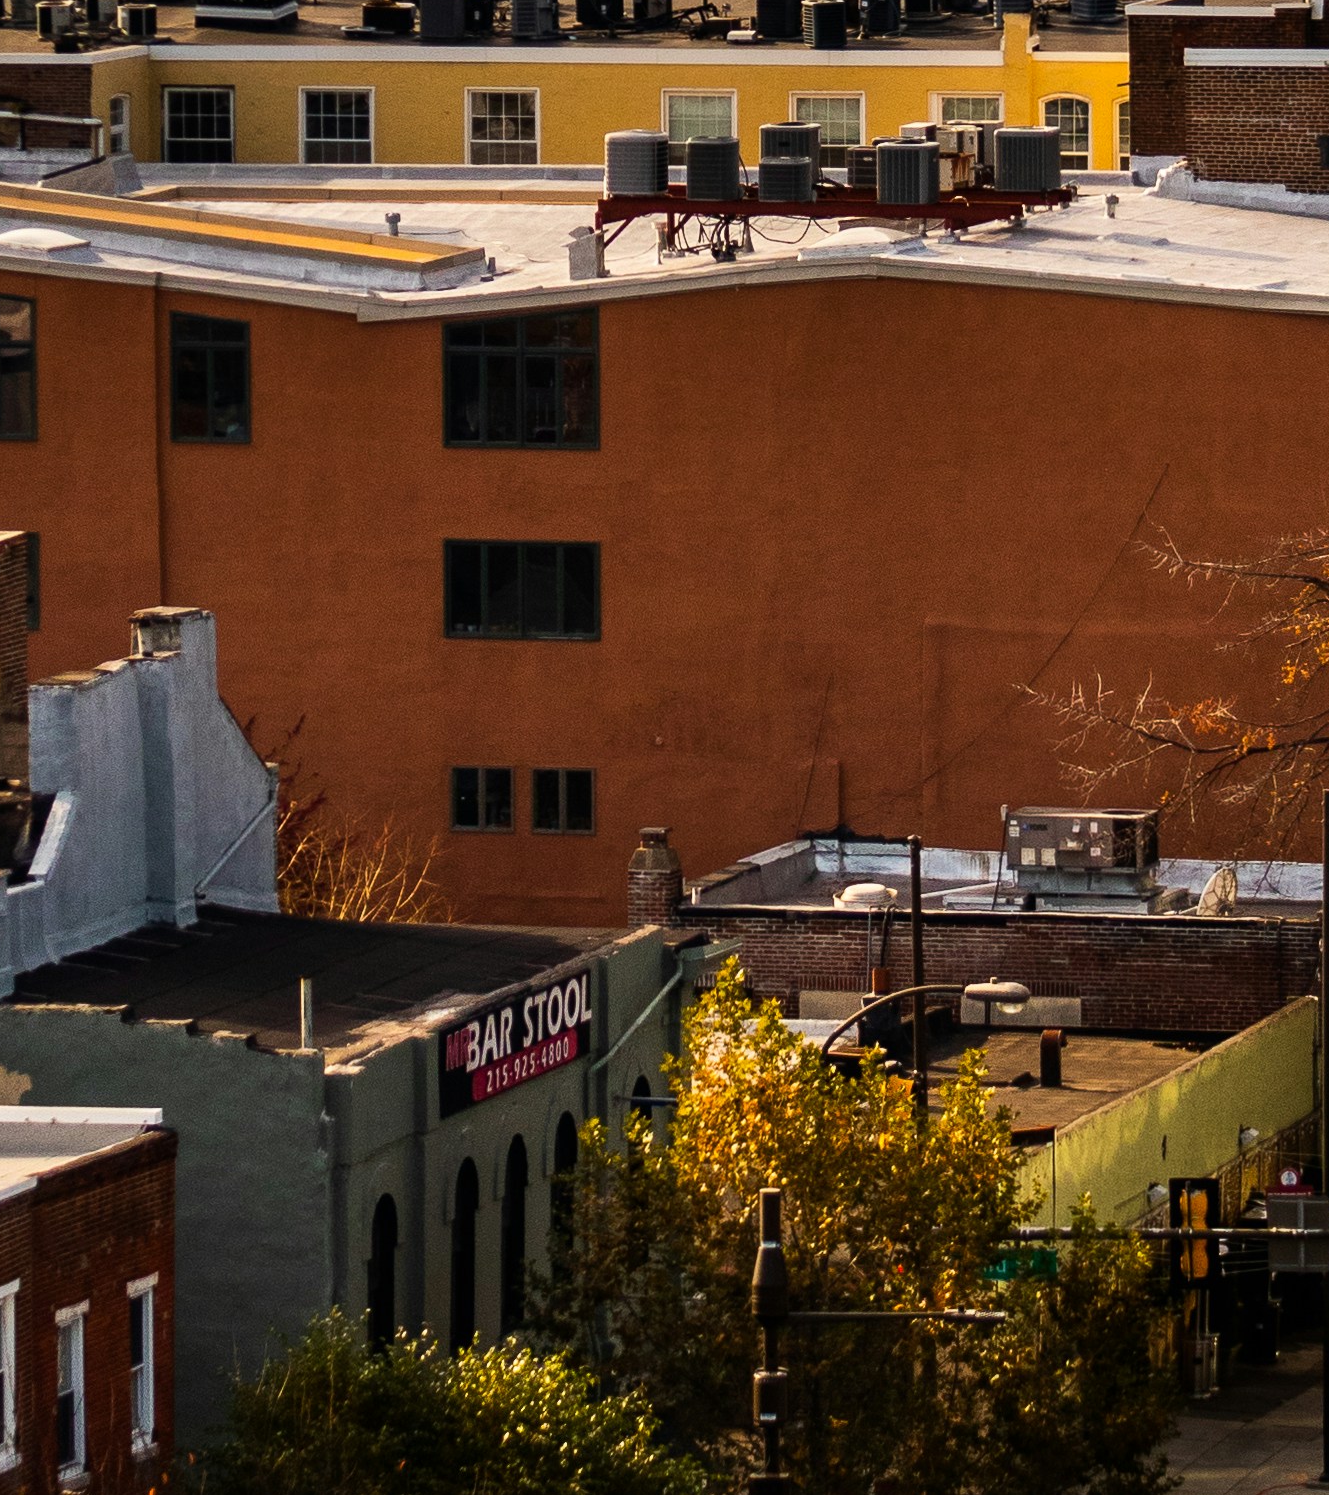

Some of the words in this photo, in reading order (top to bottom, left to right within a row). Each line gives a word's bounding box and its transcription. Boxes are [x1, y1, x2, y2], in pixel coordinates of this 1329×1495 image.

[465, 1007, 514, 1074] BAR
[522, 973, 593, 1049] STOOL
[485, 1036, 569, 1093] 215-925-4800
